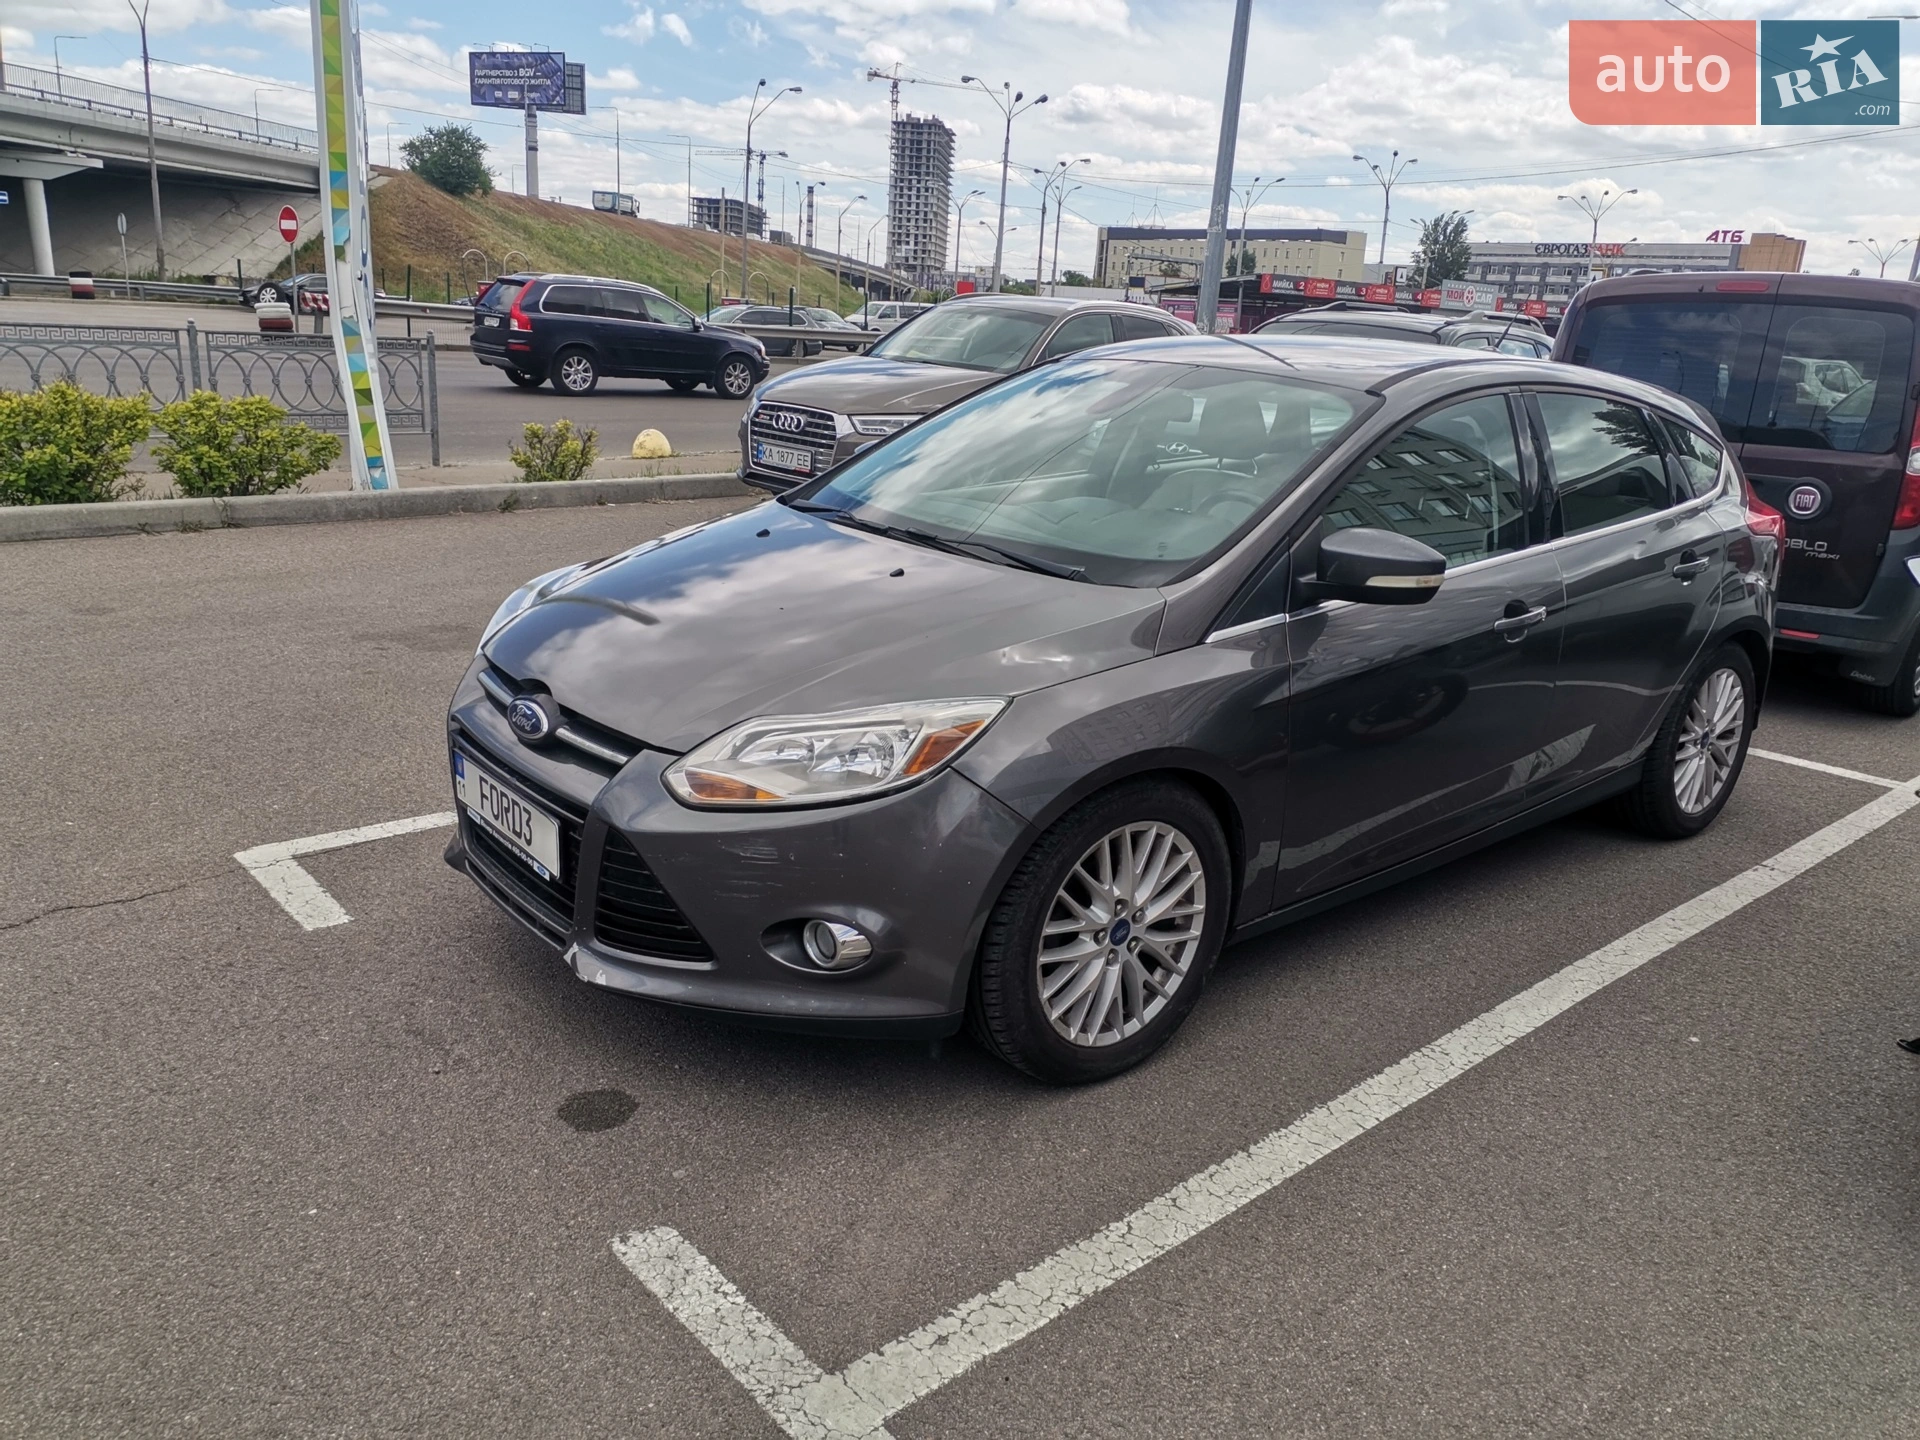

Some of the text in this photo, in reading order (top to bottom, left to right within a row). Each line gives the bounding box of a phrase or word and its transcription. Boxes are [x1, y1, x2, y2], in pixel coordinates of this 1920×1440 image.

[519, 68, 535, 77] BGV
[1705, 230, 1746, 243] АТБ
[1272, 279, 1294, 289] МИЙКА
[1299, 281, 1305, 290] 2
[1336, 285, 1356, 295] МИЙКА
[1360, 287, 1366, 295] 3
[1416, 292, 1422, 300] 4
[1475, 292, 1493, 304] CAR
[763, 447, 810, 467] KA 1877 EE
[1795, 493, 1815, 508] FIAT
[511, 704, 538, 732] Ford
[479, 774, 533, 847] FORD3
